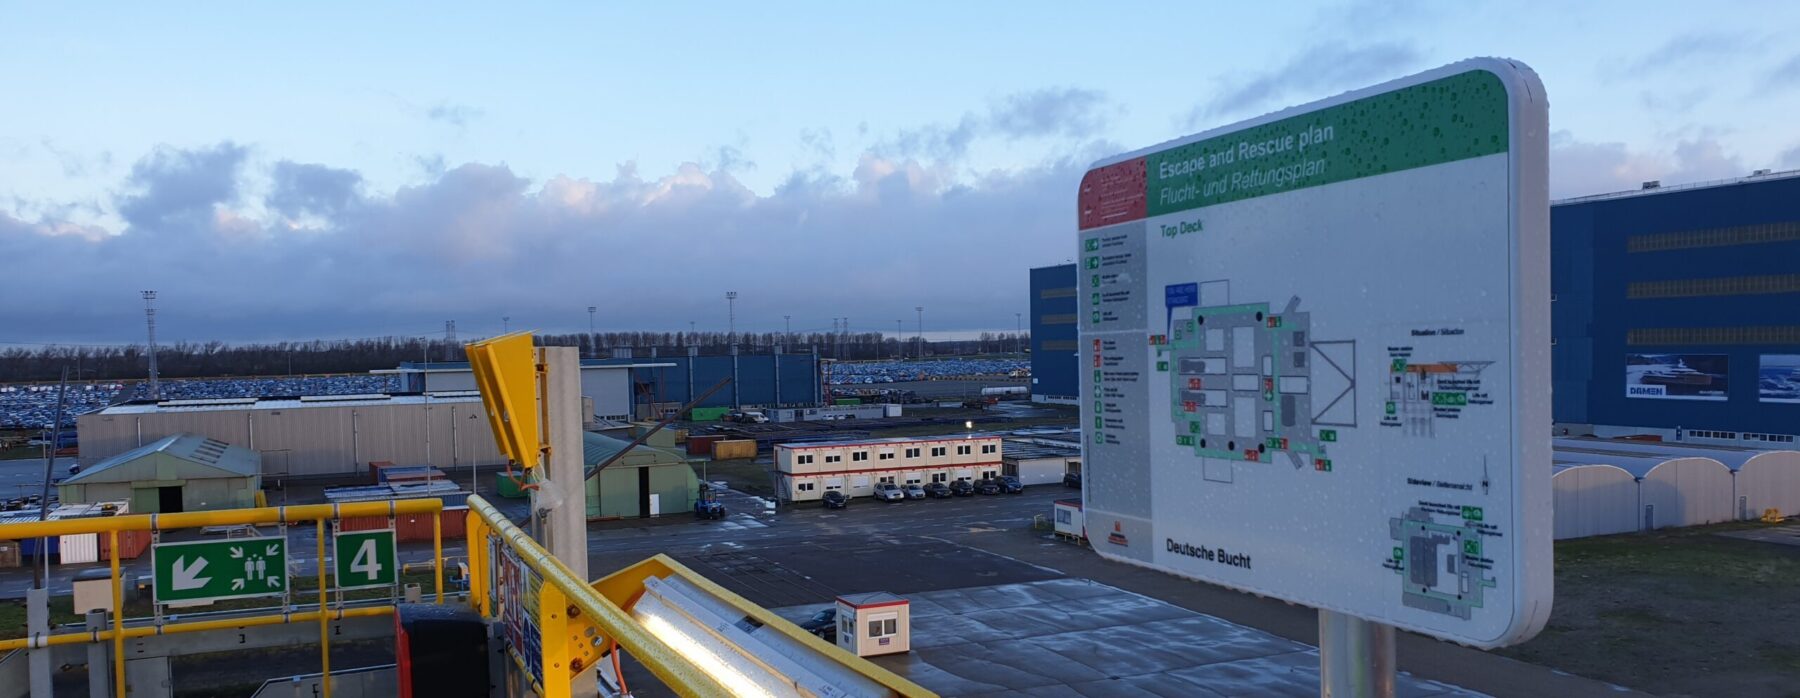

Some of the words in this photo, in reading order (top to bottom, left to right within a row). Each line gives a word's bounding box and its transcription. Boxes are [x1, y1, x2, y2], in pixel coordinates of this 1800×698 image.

[1159, 156, 1205, 179] Escape
[1209, 146, 1234, 168] and
[1238, 135, 1294, 161] Rescue
[1299, 125, 1334, 152] plan
[1160, 183, 1200, 206] Flucht-
[1203, 175, 1228, 197] und
[1231, 158, 1326, 191] Rettungsplan
[1160, 225, 1178, 239] Top
[1180, 219, 1204, 234] Deck
[1630, 387, 1663, 396] DAMEN
[350, 538, 382, 580] 4
[1166, 538, 1215, 562] Deutsche
[1217, 548, 1252, 570] Bucht
